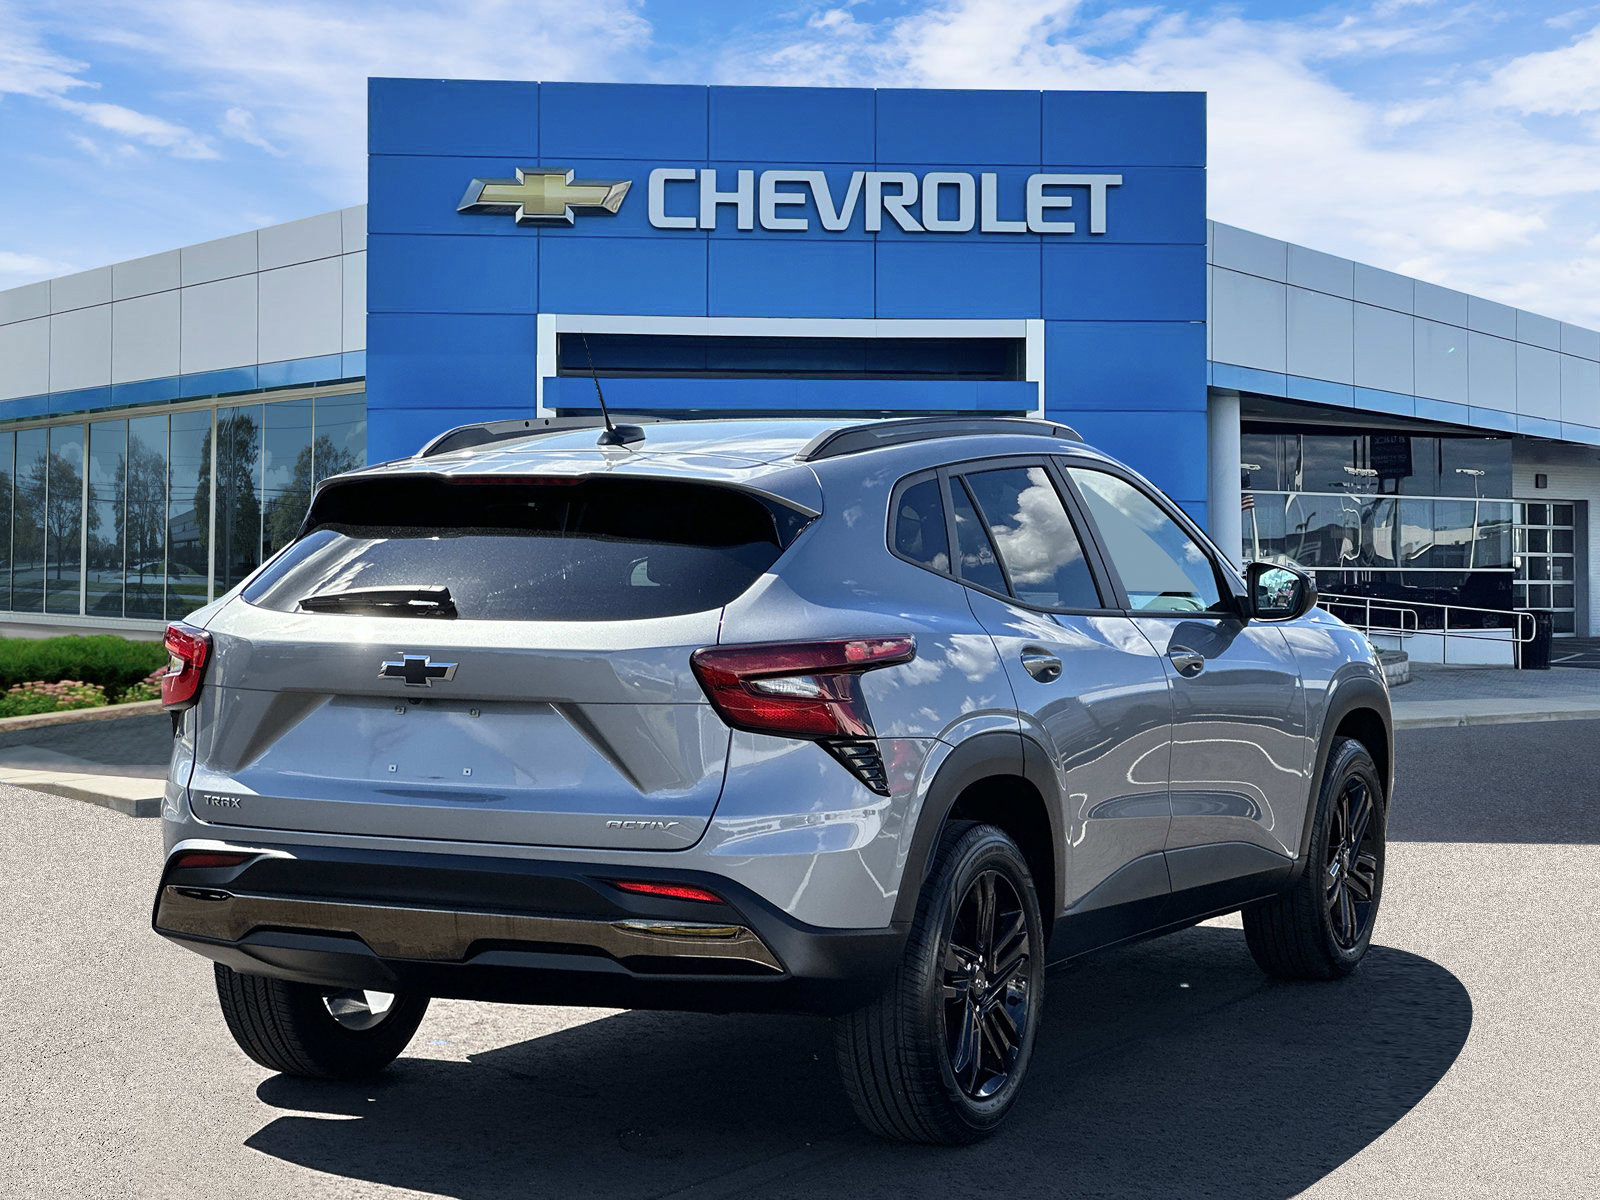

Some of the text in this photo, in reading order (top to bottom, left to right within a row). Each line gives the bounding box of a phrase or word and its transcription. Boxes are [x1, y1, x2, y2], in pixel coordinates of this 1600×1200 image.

[648, 168, 1123, 233] CHEVROLET
[204, 795, 241, 808] TRAX
[606, 820, 680, 830] ACTIV
